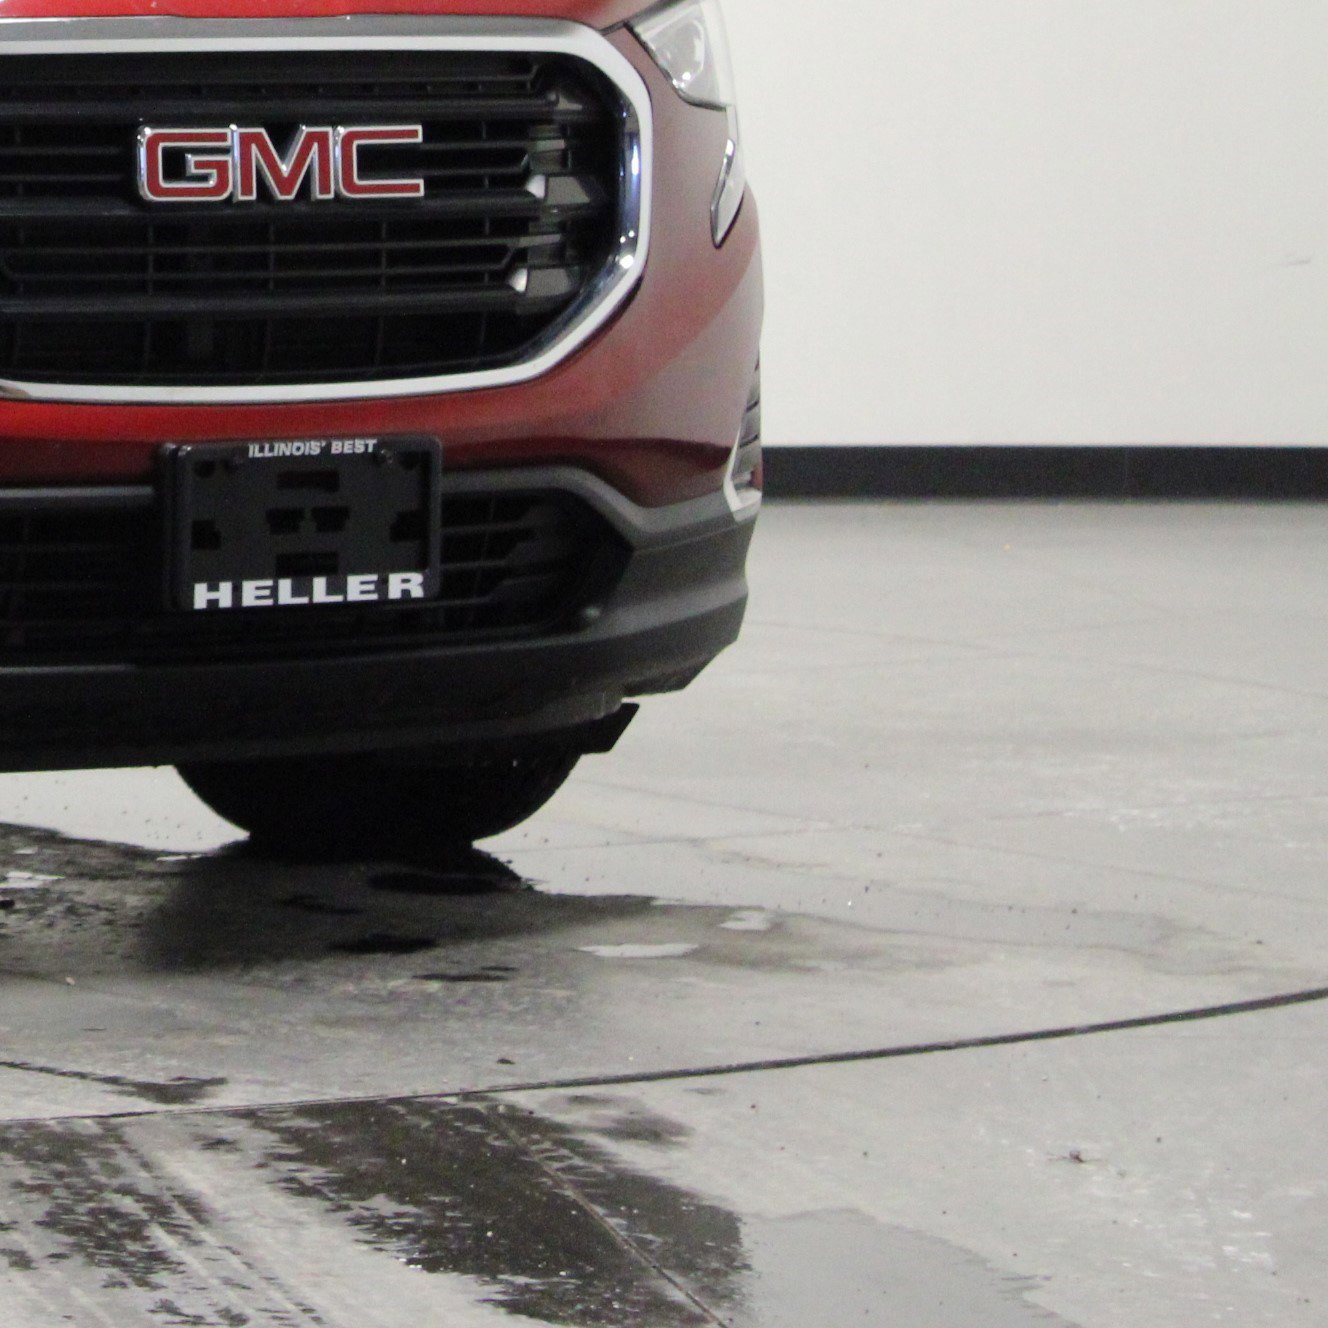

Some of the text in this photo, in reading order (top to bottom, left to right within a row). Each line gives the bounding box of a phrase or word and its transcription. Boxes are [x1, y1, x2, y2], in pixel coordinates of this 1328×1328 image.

[136, 123, 425, 203] GMC
[331, 438, 378, 455] BEST
[193, 572, 425, 611] HELLER
